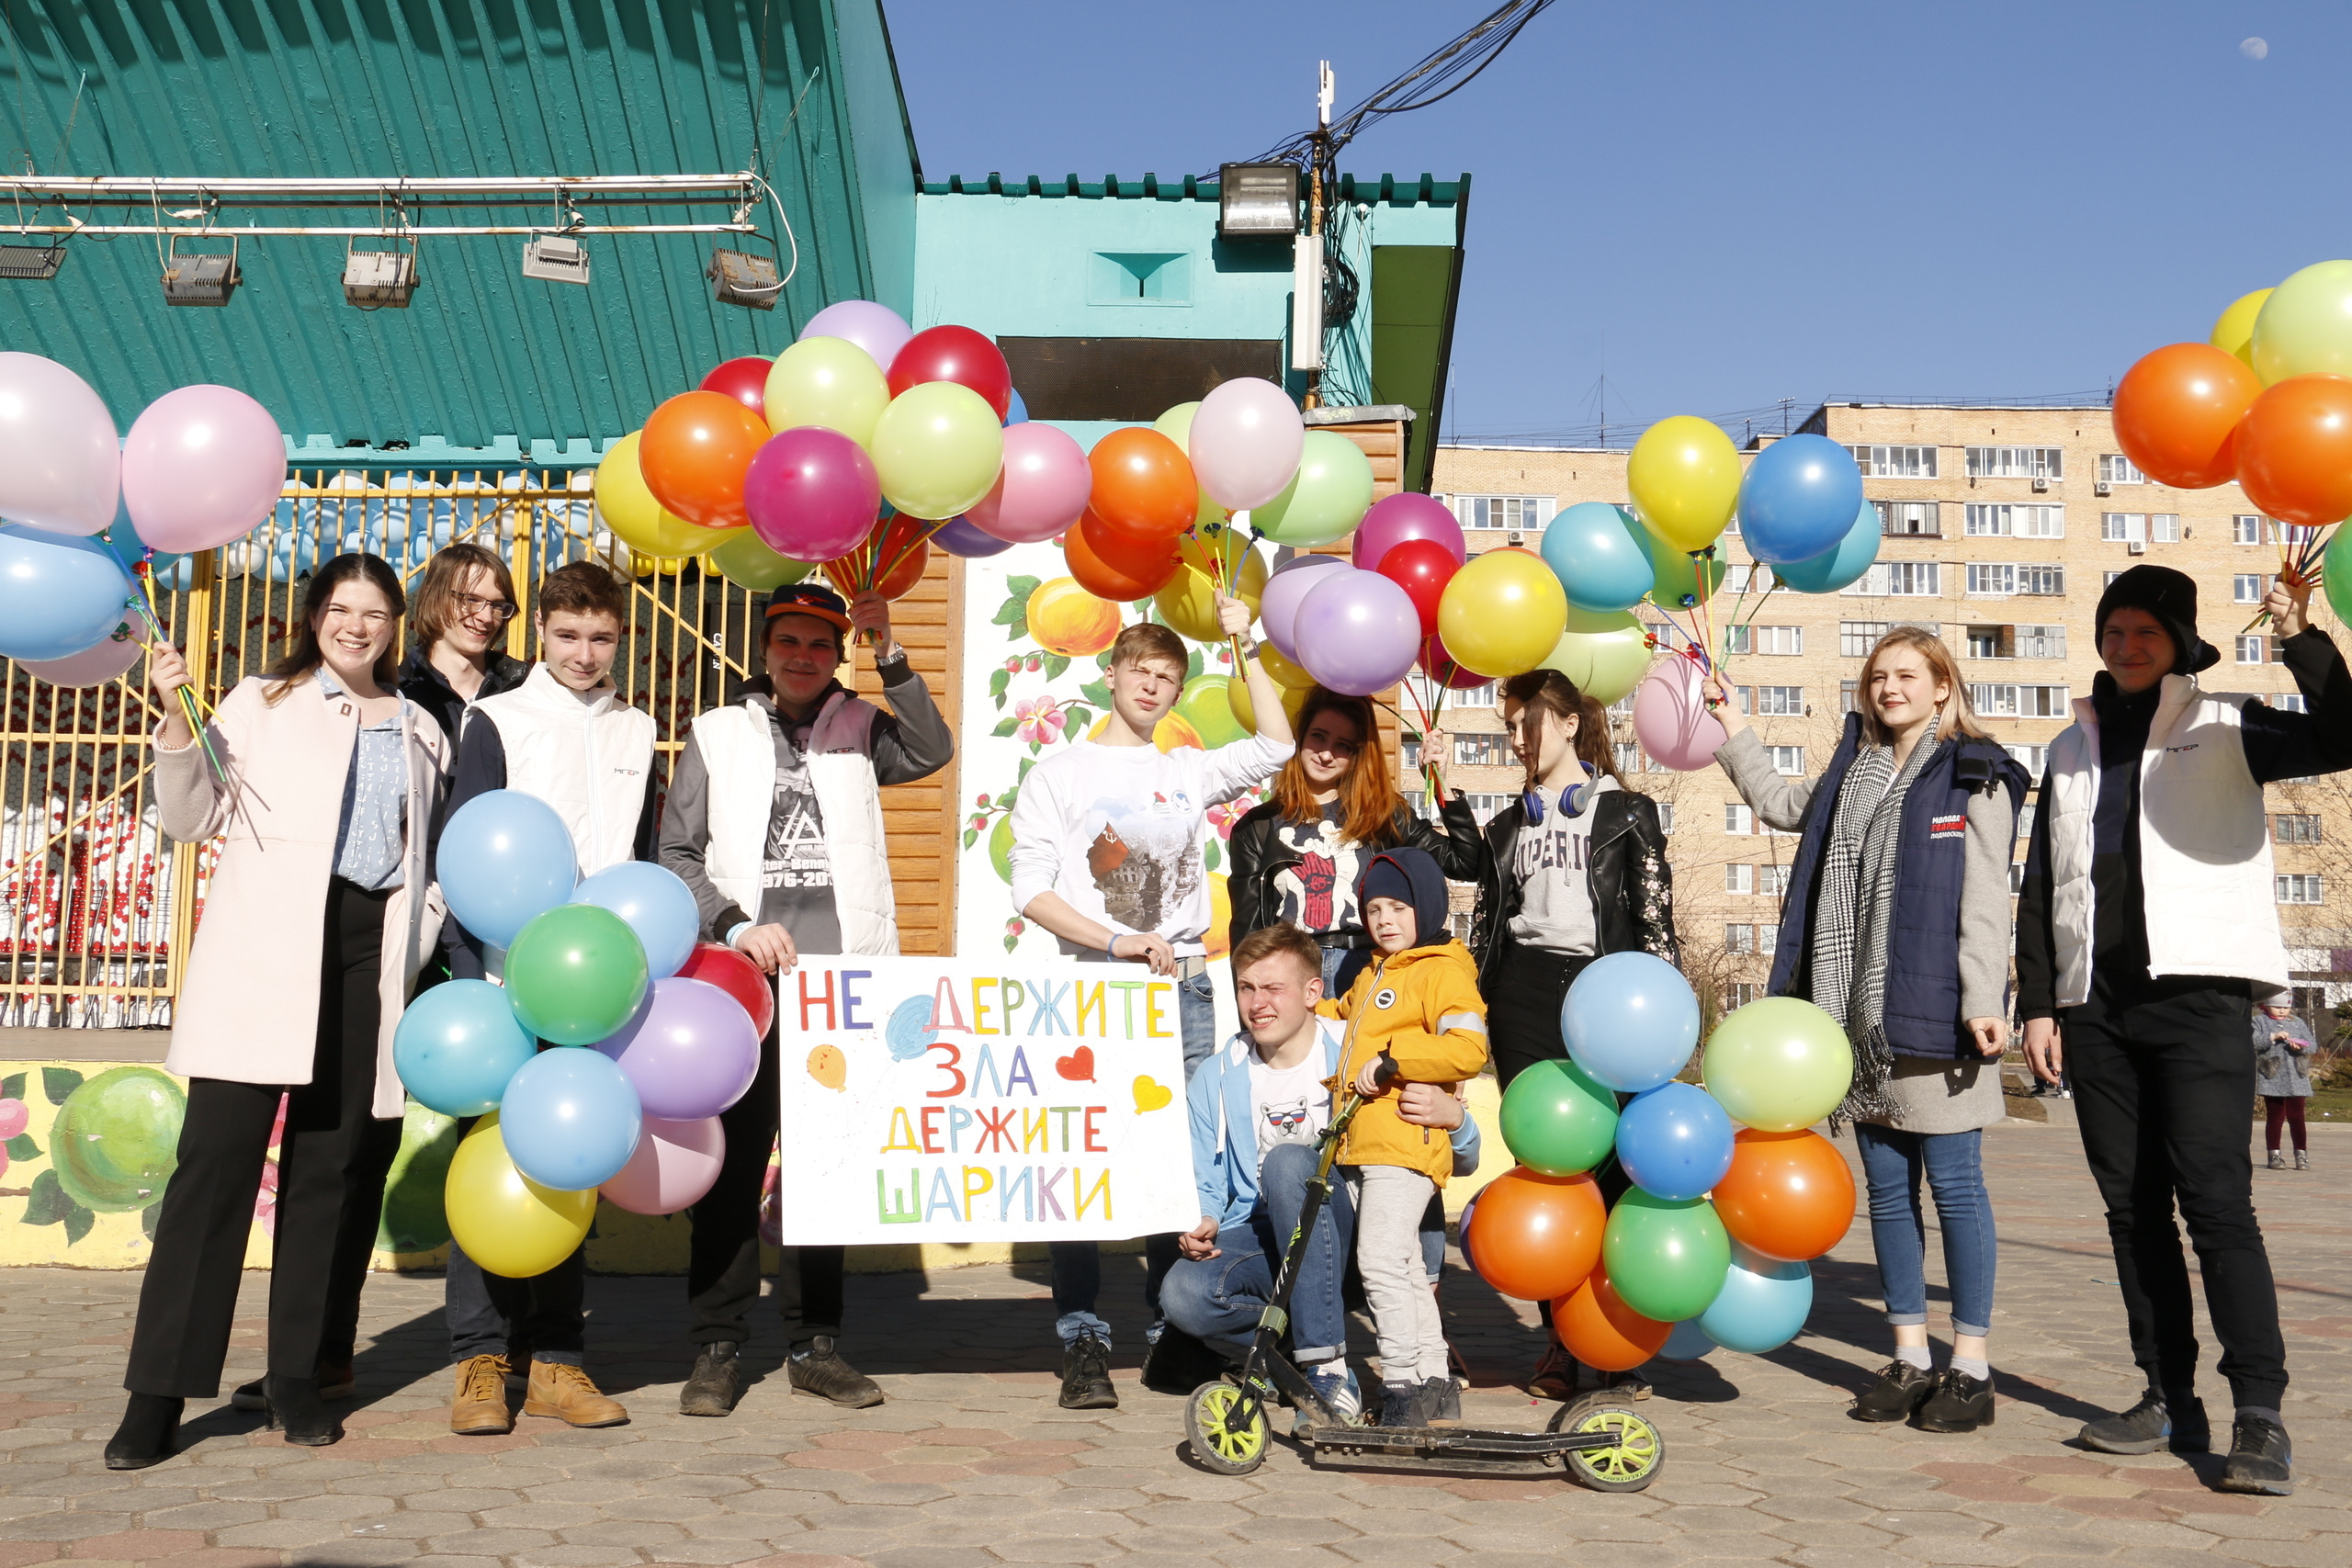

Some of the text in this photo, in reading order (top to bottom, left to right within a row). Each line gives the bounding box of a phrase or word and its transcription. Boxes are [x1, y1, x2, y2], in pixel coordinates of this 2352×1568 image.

[798, 970, 1174, 1040] НЕ ДЕРЖИТЕ
[925, 1043, 1038, 1098] ЗЛА
[879, 1104, 1108, 1154] ДЕРЖИТЕ
[876, 1165, 1113, 1224] ШАРИКИ
